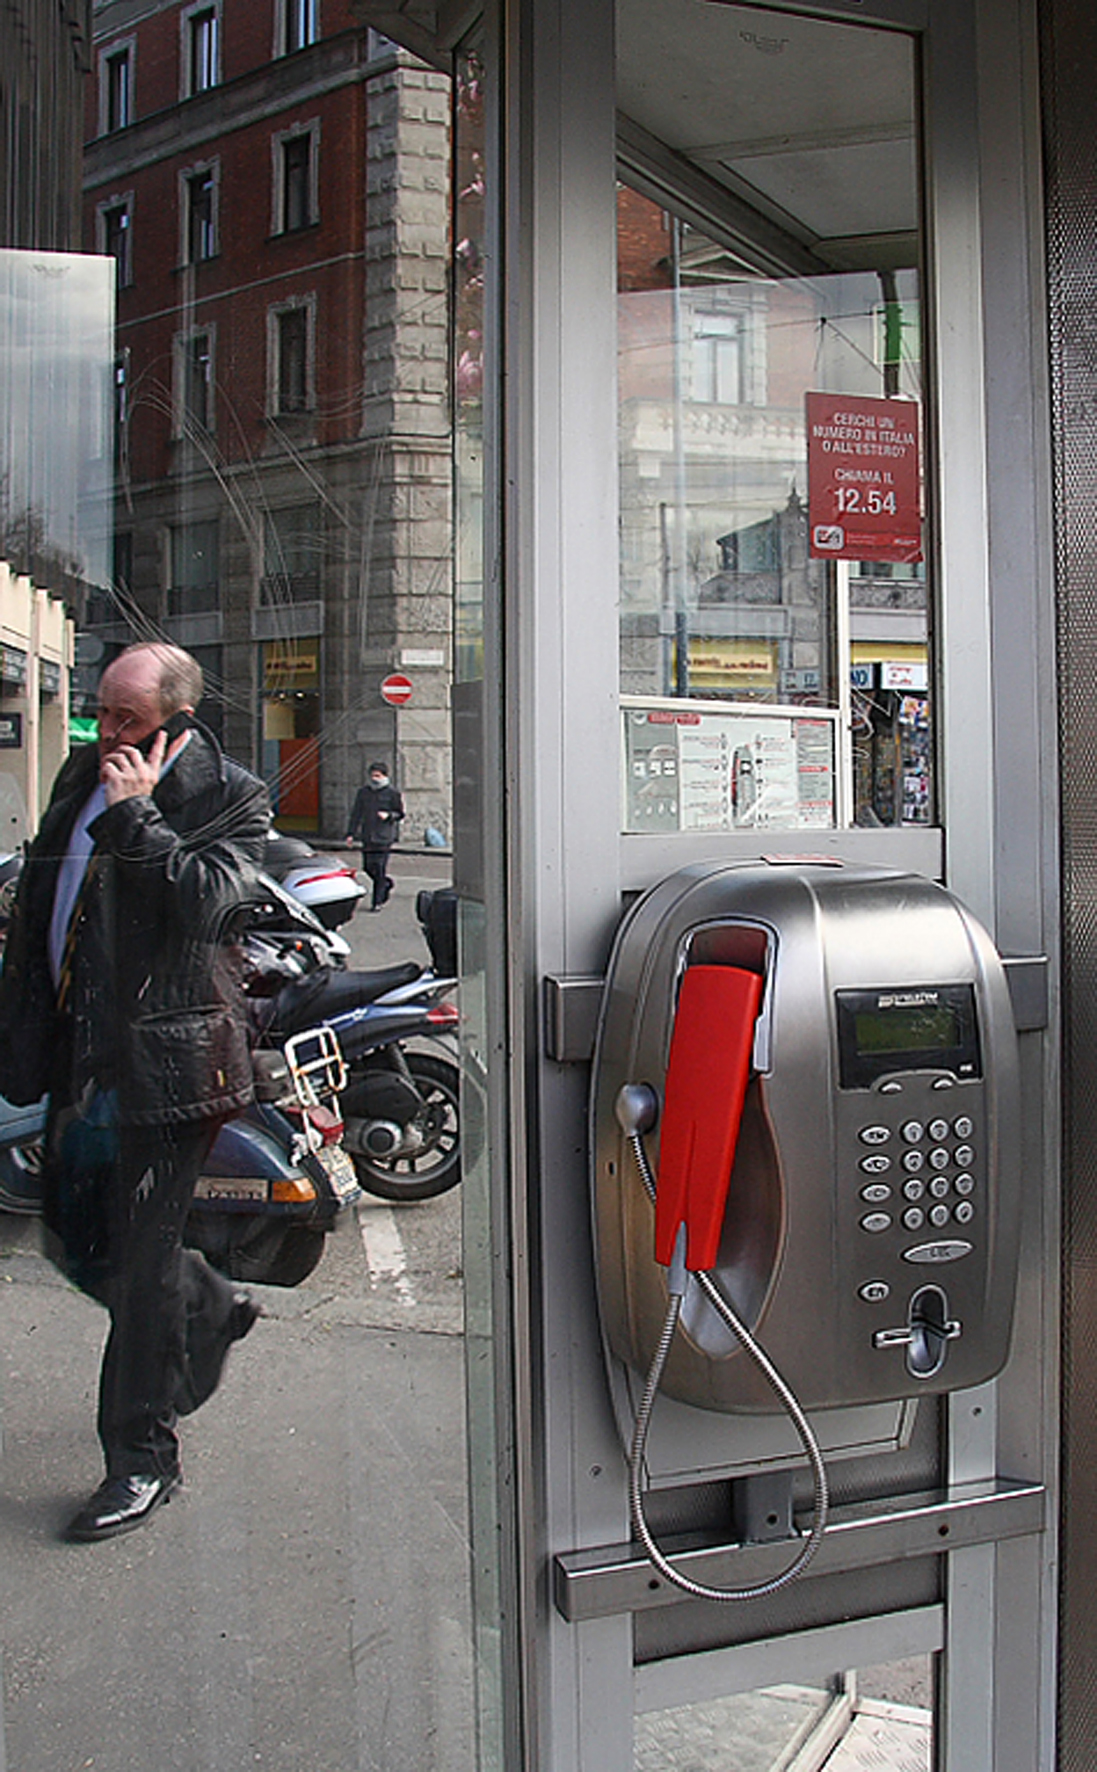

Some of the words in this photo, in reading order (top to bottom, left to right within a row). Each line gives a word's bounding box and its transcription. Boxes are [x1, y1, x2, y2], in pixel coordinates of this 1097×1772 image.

[813, 425, 862, 441] NUMERO
[879, 431, 915, 445] ITALIA
[834, 467, 882, 482] CHIAMA
[883, 472, 895, 485] IL
[834, 487, 896, 516] 12.54
